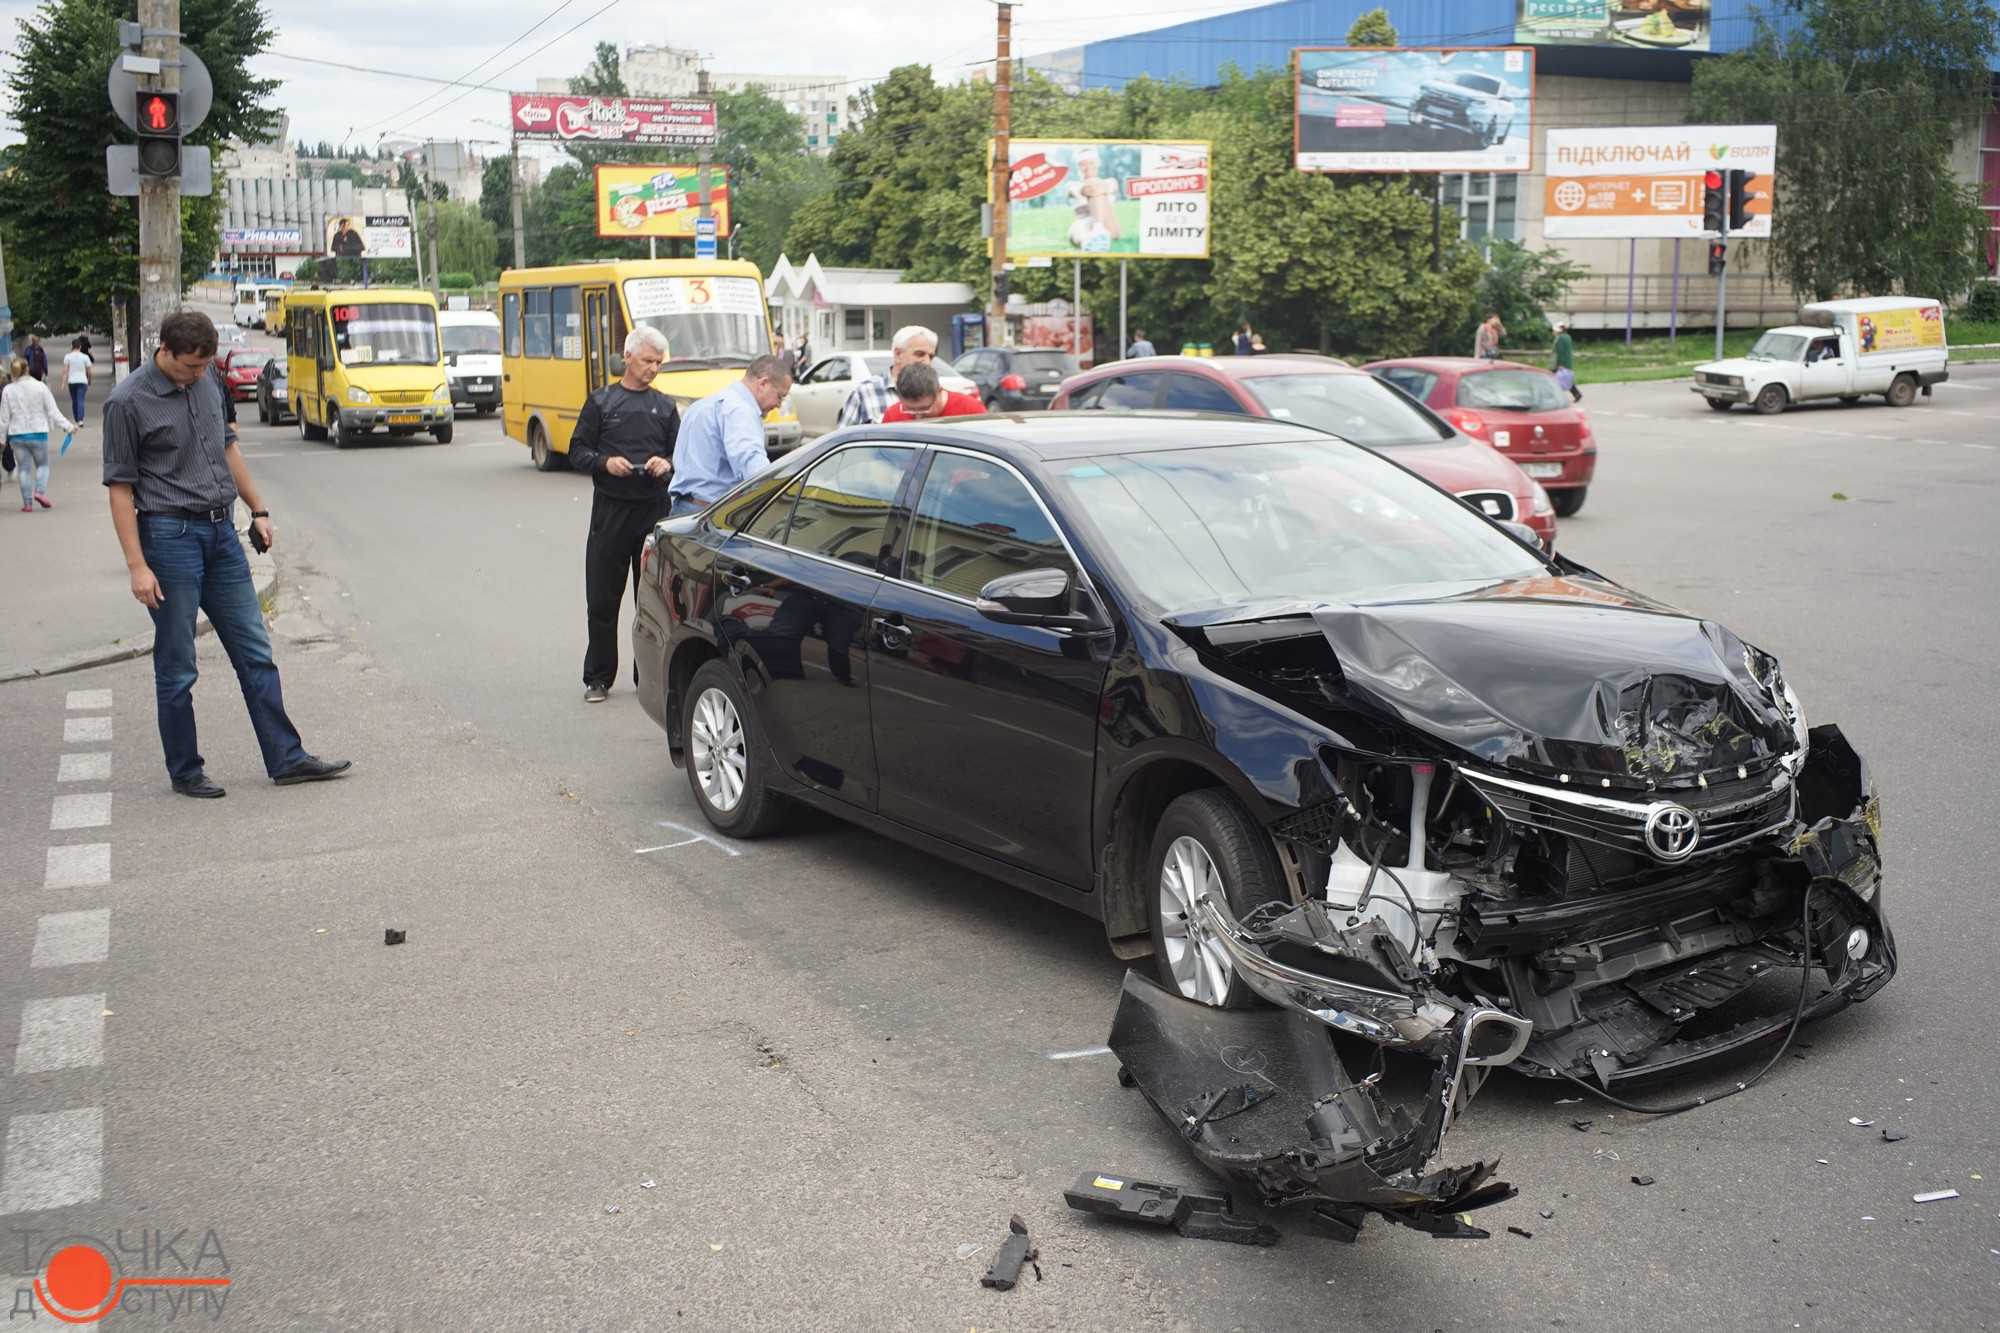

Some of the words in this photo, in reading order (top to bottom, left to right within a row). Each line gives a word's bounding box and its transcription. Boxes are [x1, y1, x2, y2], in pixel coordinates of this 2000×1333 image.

[591, 98, 626, 123] Rock
[1558, 141, 1691, 165] ПІДКЛЮЧАЙ
[1156, 202, 1198, 213] ЛІТО
[371, 217, 405, 226] MILANO
[1148, 227, 1206, 238] ЛІМІТУ
[689, 280, 710, 304] 3
